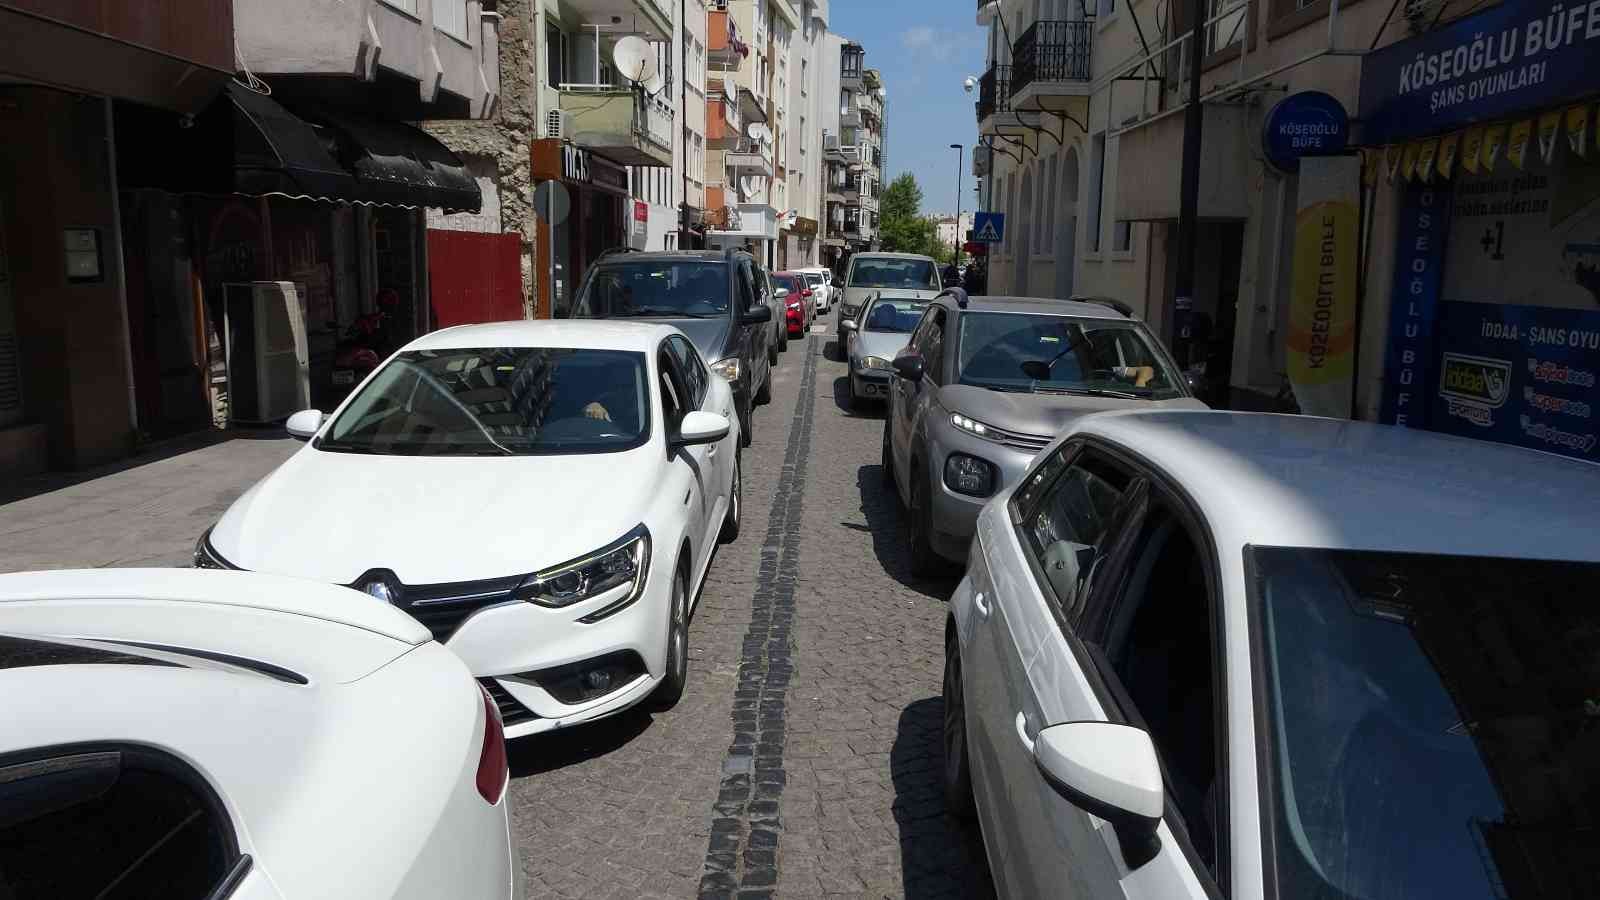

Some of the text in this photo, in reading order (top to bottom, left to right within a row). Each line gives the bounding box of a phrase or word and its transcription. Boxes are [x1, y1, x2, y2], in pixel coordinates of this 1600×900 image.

[1399, 1, 1600, 95] KÖSEOĞLU BÜFE
[1431, 60, 1547, 115] ŞANS OYUNLARI
[1279, 121, 1339, 136] KÖSEOĞLU
[1291, 136, 1321, 149] BÜFE
[1480, 221, 1505, 260] +1
[1405, 187, 1433, 337] ÖSEOĞLU
[1529, 326, 1567, 347] ŞANS
